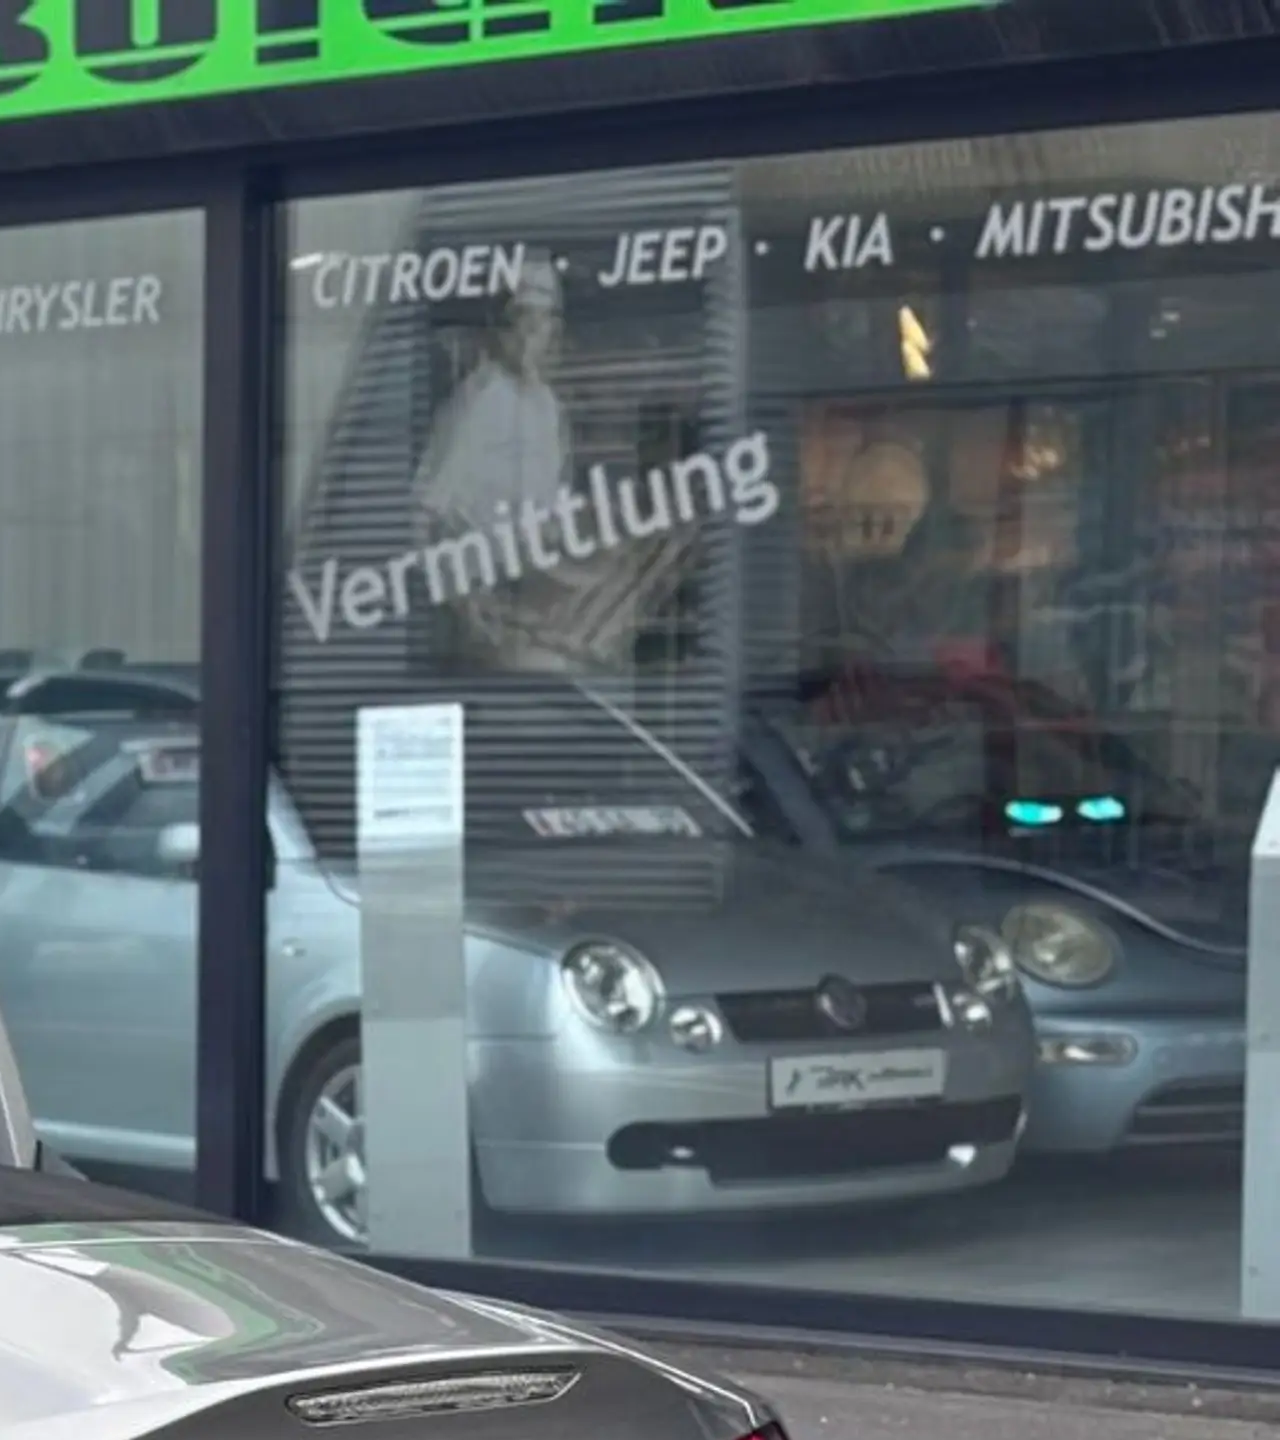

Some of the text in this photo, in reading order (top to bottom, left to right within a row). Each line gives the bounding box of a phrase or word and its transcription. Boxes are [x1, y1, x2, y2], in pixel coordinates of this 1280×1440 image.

[313, 242, 525, 310] CITROEN
[597, 225, 728, 288] JEEP
[804, 213, 895, 271] KIA
[287, 430, 780, 643] Vermittlung
